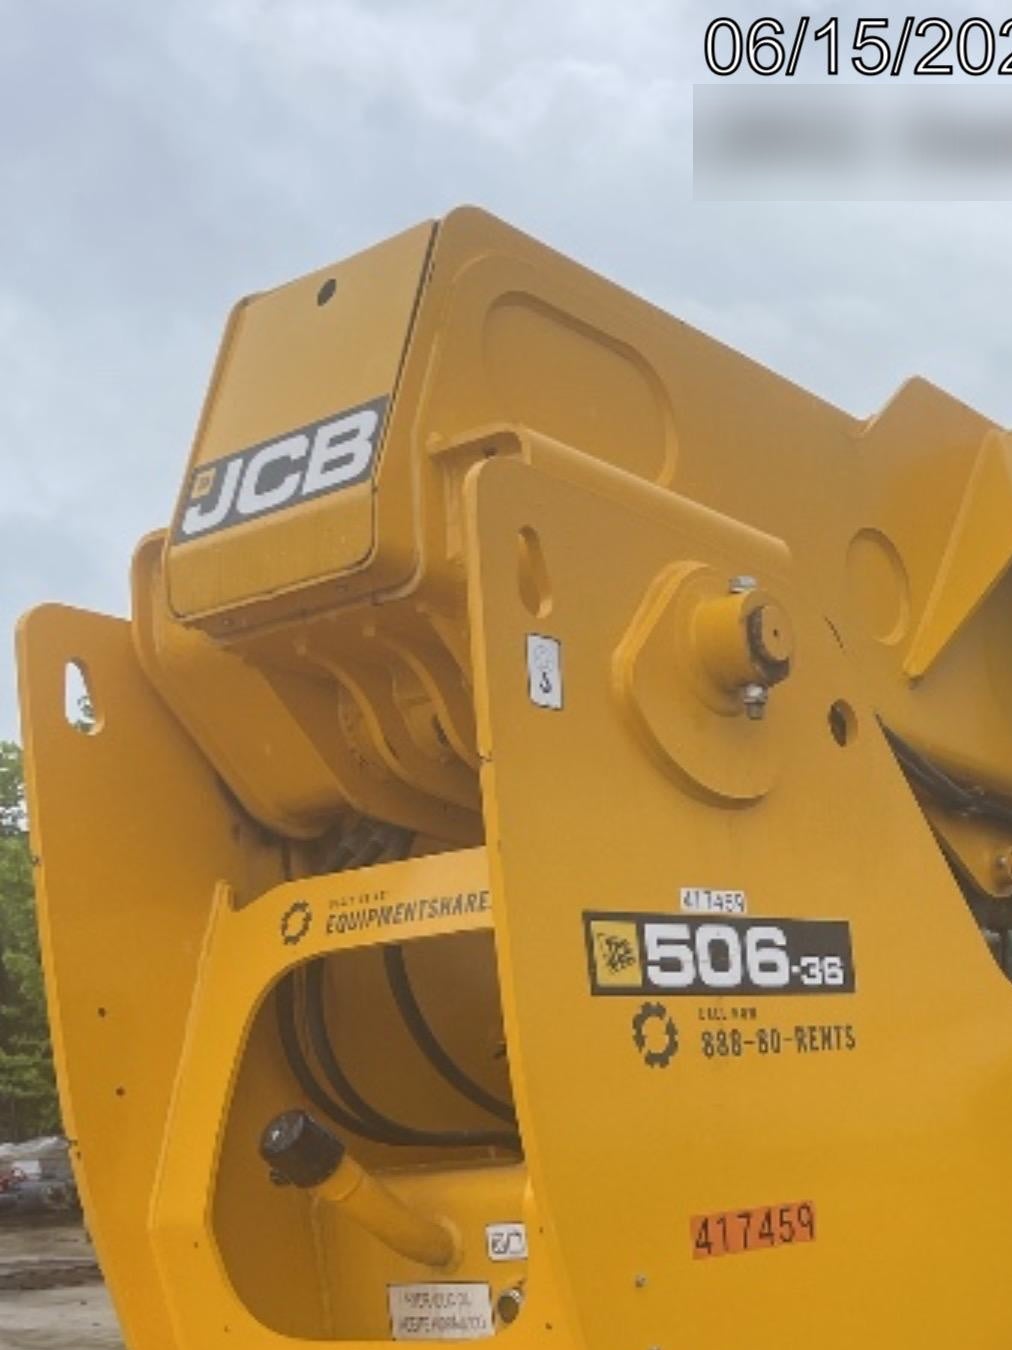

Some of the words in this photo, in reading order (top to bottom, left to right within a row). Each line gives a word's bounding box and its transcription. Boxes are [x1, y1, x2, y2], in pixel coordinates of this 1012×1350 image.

[182, 409, 380, 536] JCB
[683, 889, 745, 912] 417459
[694, 1201, 816, 1255] 417459
